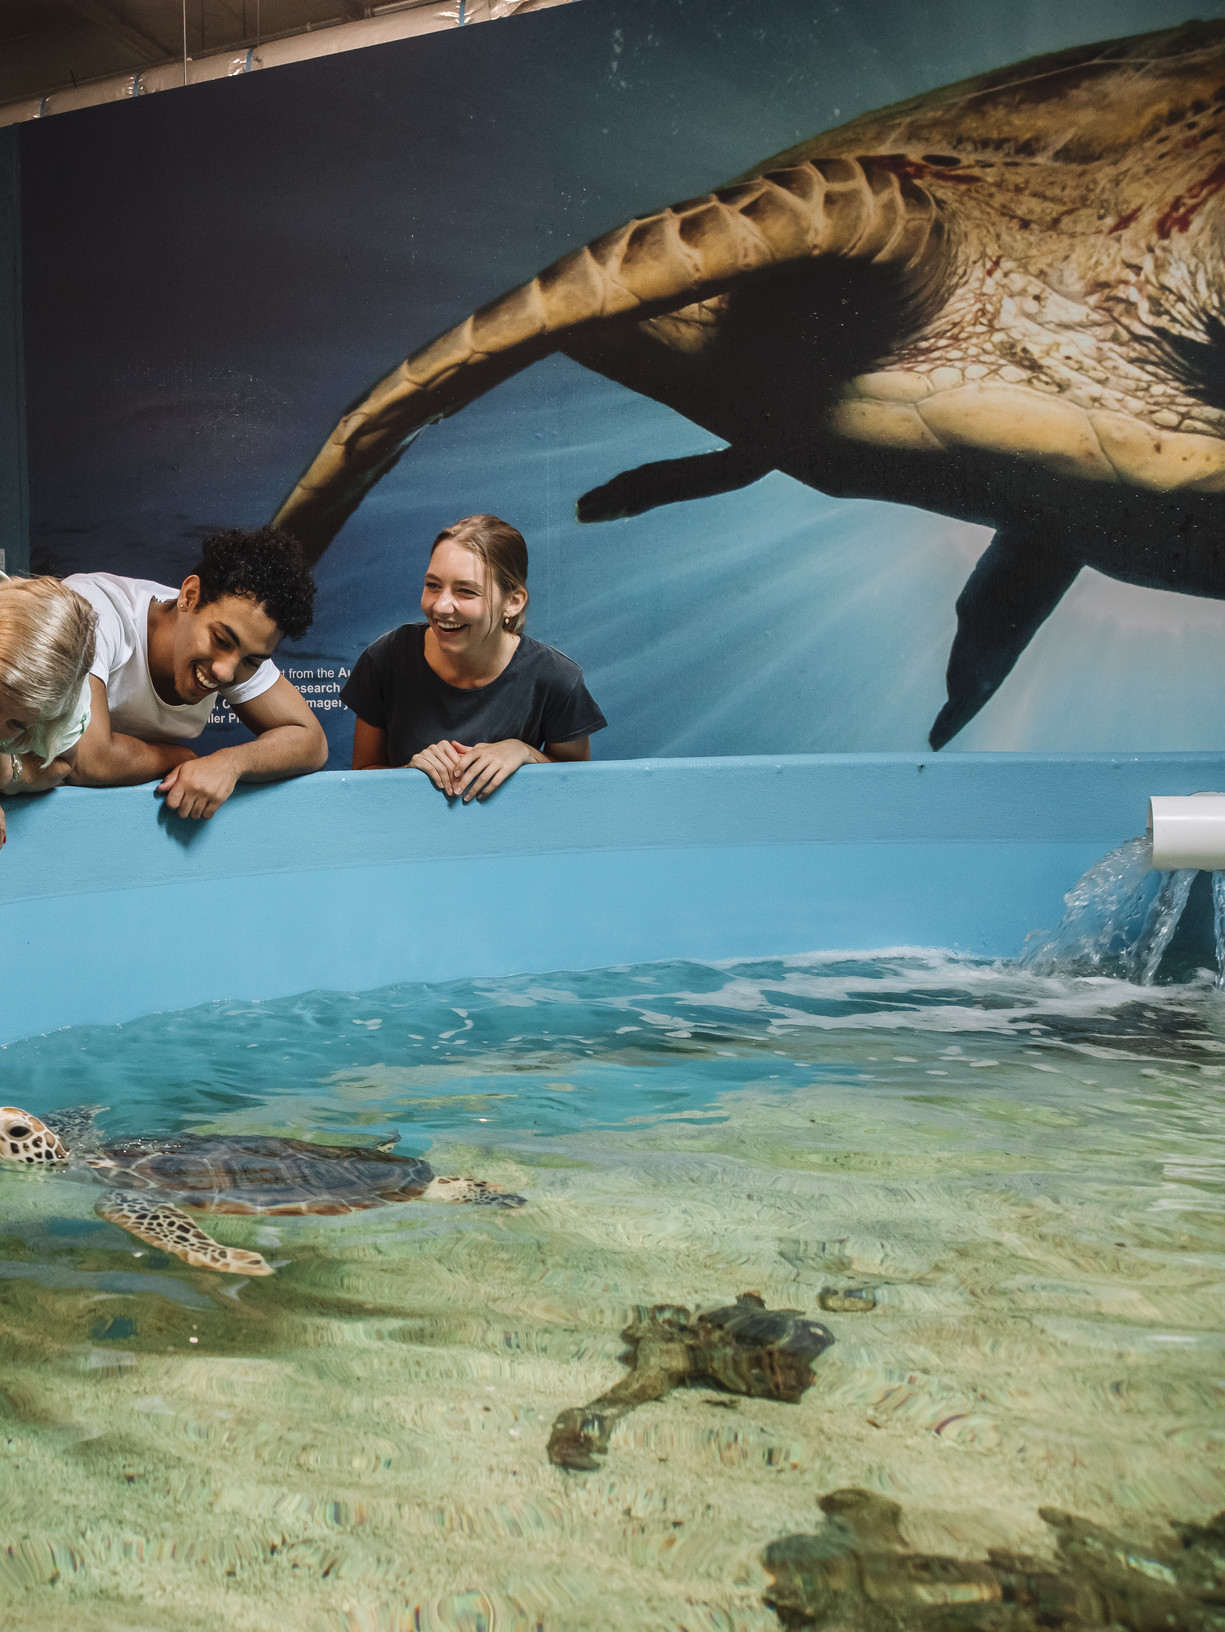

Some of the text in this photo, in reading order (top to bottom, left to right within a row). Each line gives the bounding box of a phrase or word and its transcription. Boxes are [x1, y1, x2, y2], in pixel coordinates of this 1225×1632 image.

[288, 668, 314, 678] from
[317, 668, 335, 678] the
[294, 682, 341, 693] esearch
